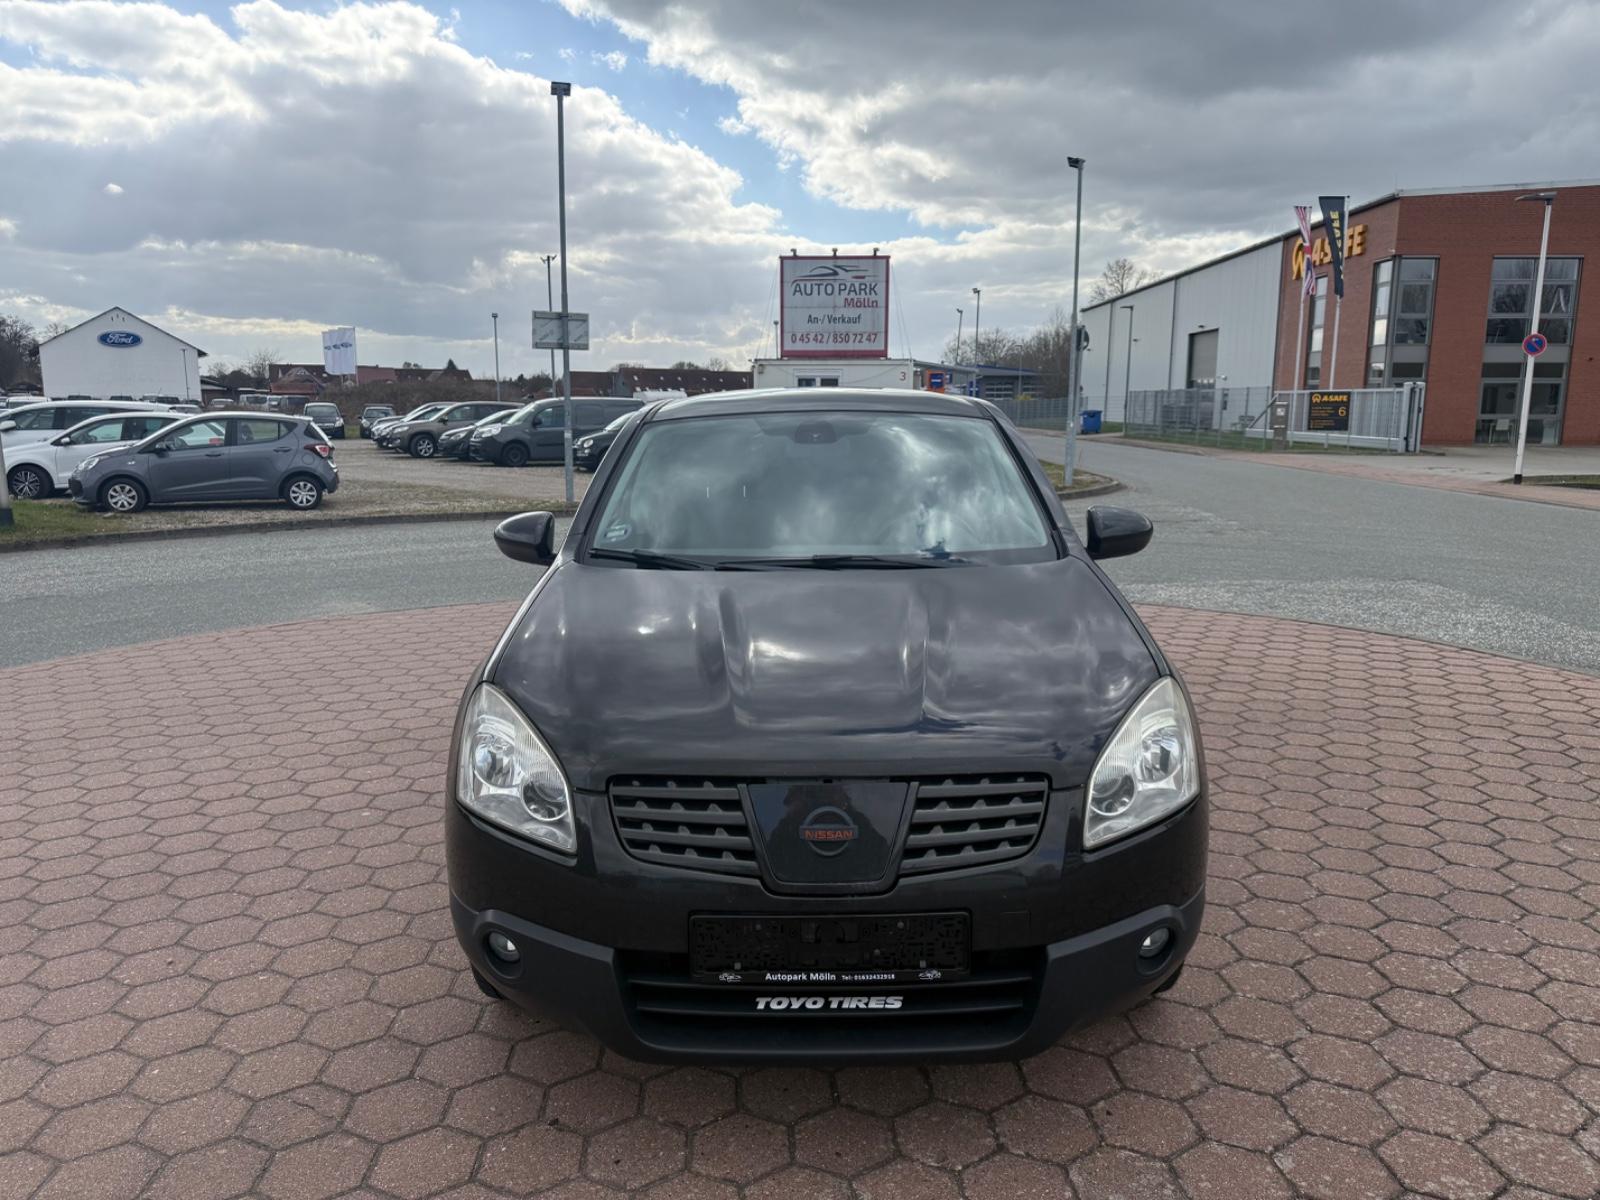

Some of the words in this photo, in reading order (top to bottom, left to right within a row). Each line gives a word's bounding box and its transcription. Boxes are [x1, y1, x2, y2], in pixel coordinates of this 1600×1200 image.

[793, 283, 834, 296] AUTO
[838, 283, 878, 296] PARK
[844, 298, 879, 308] Mölln
[827, 314, 861, 324] Verkauf
[107, 331, 134, 343] Ford
[791, 334, 797, 344] 0
[799, 334, 811, 344] 45
[812, 334, 824, 344] 42
[833, 333, 850, 344] 850
[853, 333, 864, 344] 72
[866, 333, 878, 344] 47
[899, 372, 907, 381] 3
[1338, 406, 1347, 417] 6
[804, 830, 853, 839] NISSAN
[765, 972, 807, 982] Autopark
[810, 973, 836, 981] Mölln
[755, 996, 825, 1010] TOYO
[828, 996, 904, 1009] TIRES
